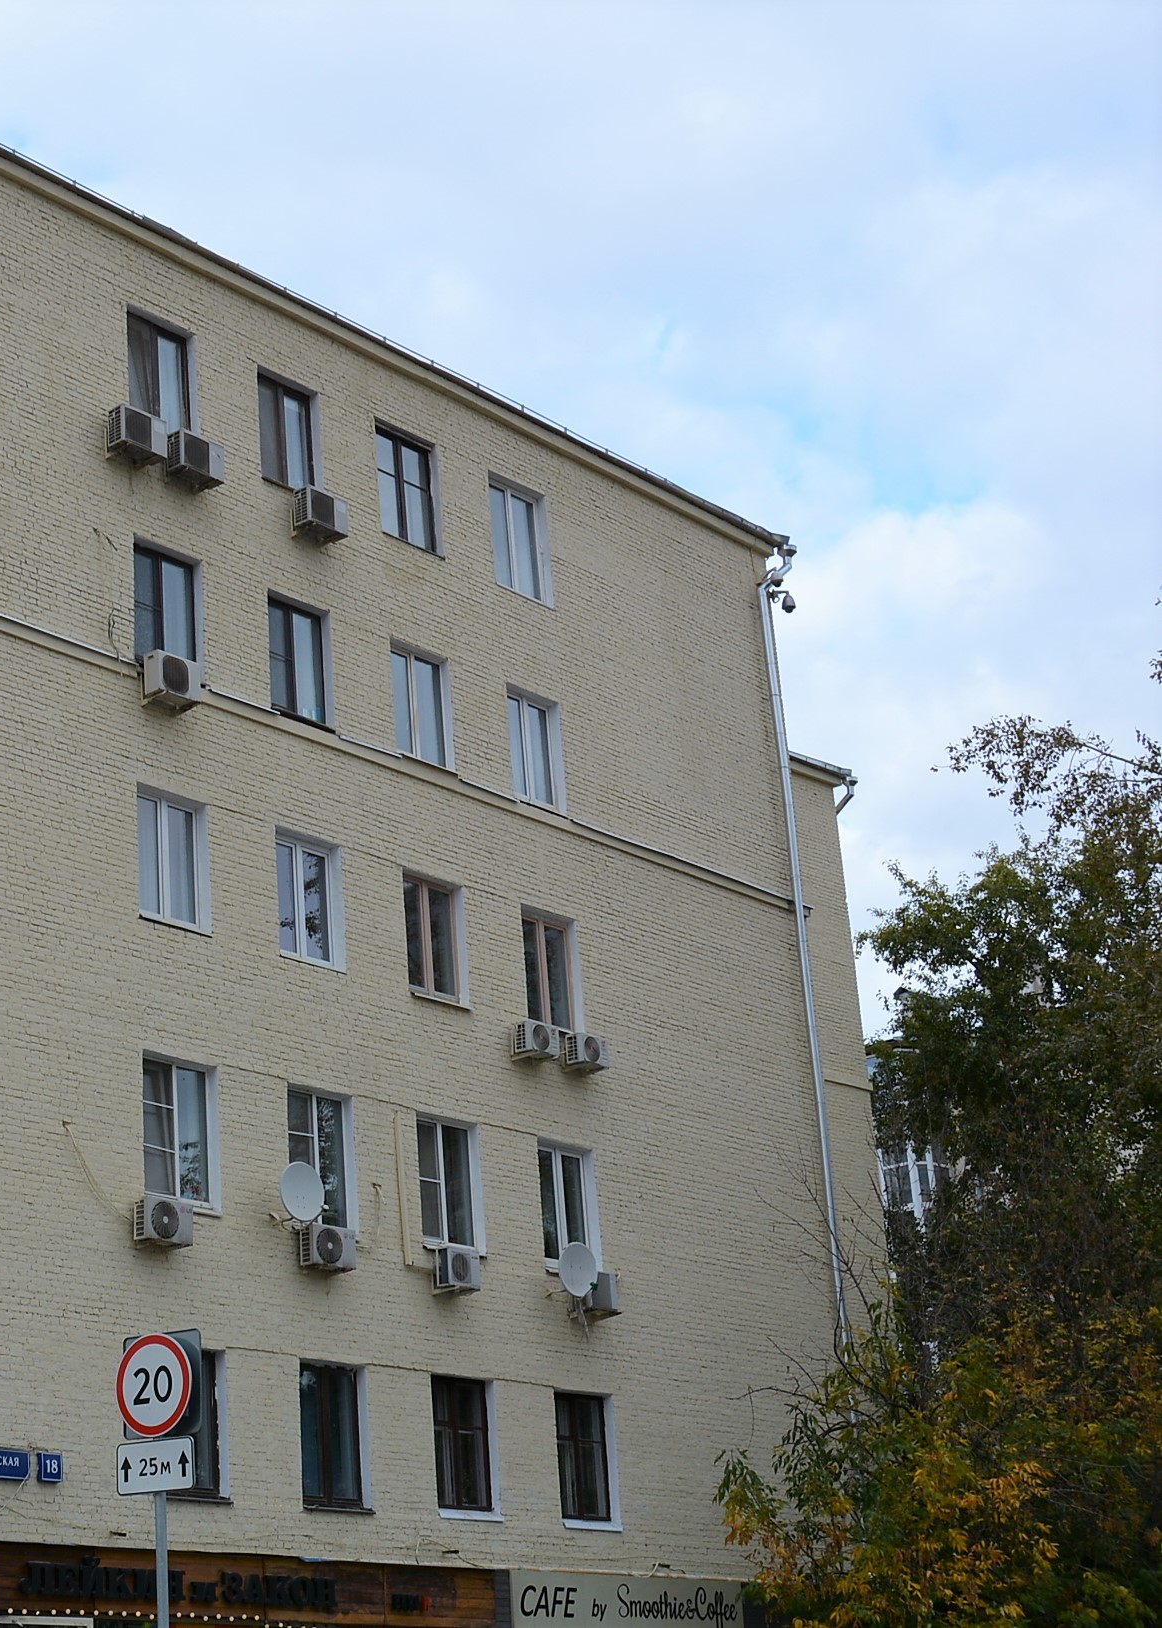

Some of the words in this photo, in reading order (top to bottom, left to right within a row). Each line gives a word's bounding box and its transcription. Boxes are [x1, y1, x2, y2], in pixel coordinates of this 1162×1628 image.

[133, 1365, 173, 1406] 20
[45, 1459, 58, 1474] 18
[221, 1569, 337, 1609] ЗАКОН
[520, 1585, 577, 1618] CAFE
[591, 1598, 607, 1621] by
